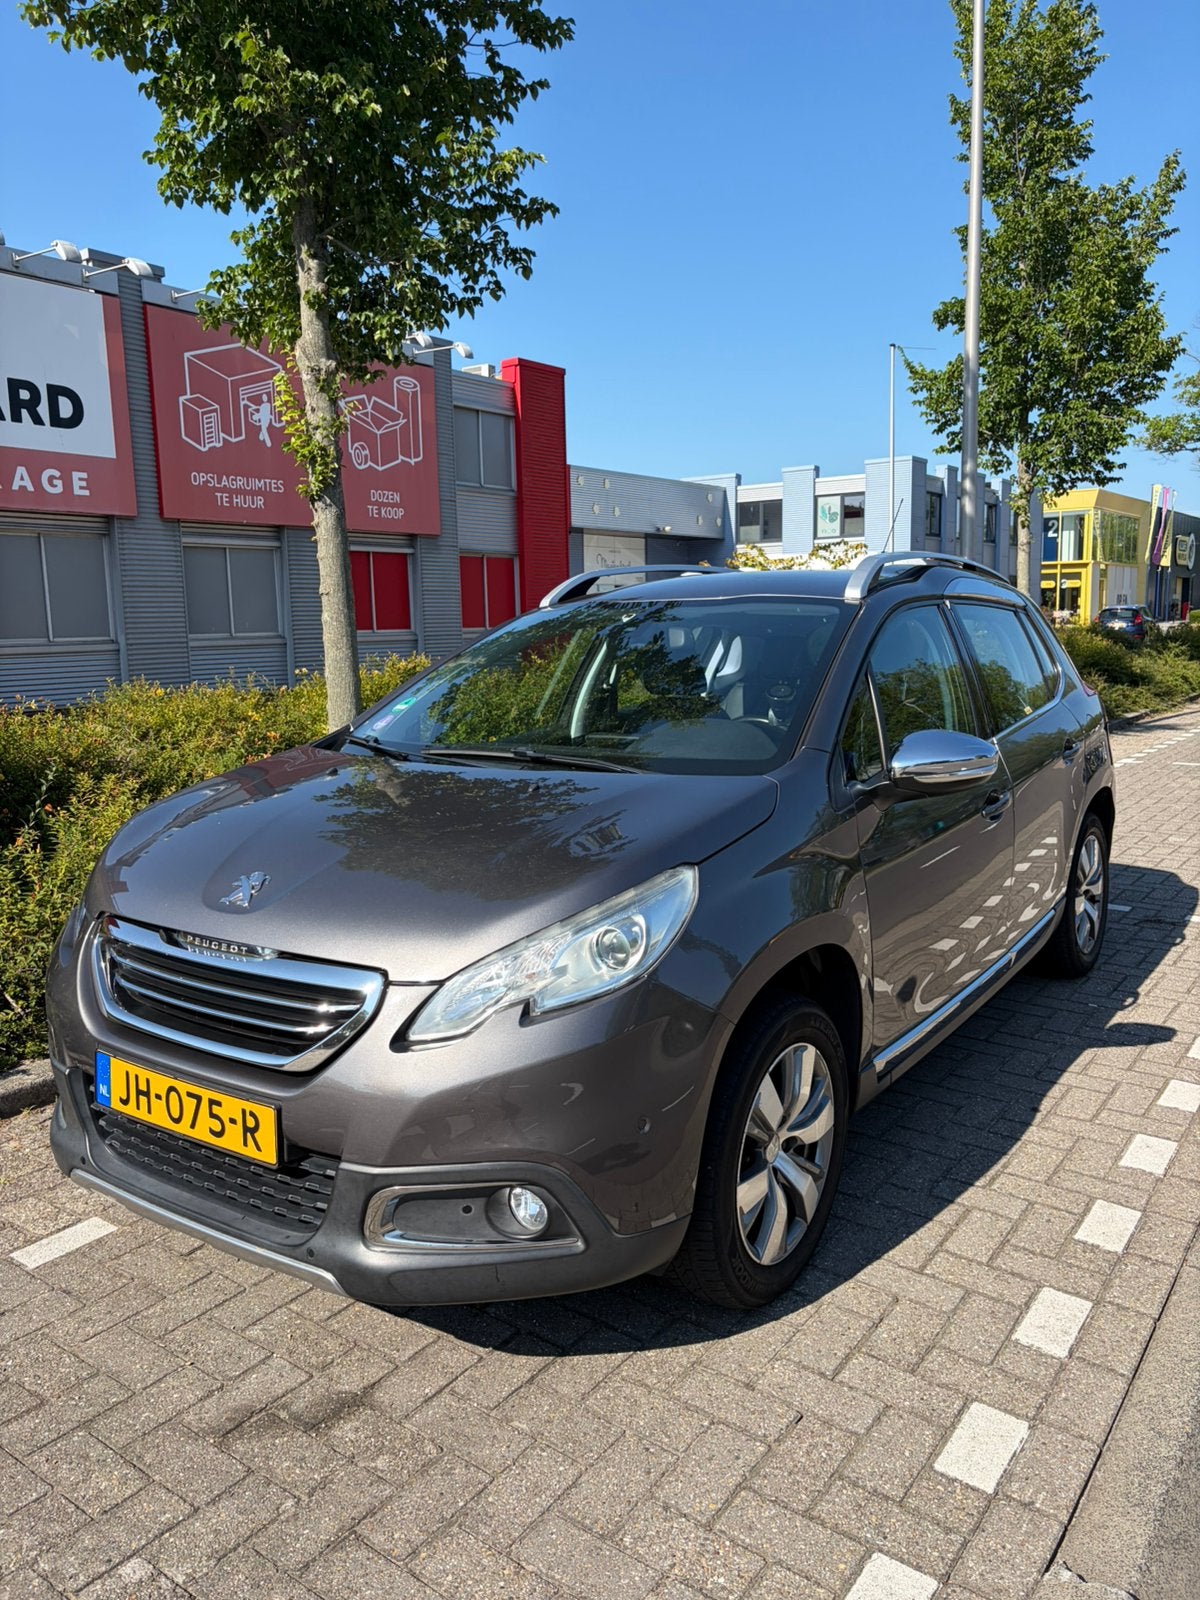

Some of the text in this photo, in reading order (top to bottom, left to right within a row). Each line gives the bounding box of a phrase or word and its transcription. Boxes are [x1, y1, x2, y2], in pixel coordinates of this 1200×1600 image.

[0, 377, 84, 430] RD
[0, 465, 91, 496] AGE
[191, 472, 285, 493] OPSLAGRUIMTES
[215, 492, 265, 509] TE HUUR
[370, 489, 401, 504] DOZEN
[367, 505, 405, 520] TE KOOP
[1047, 519, 1059, 538] 2
[186, 934, 248, 955] PEUGEOT
[99, 1083, 110, 1098] NL
[119, 1069, 263, 1153] JH-075-R
